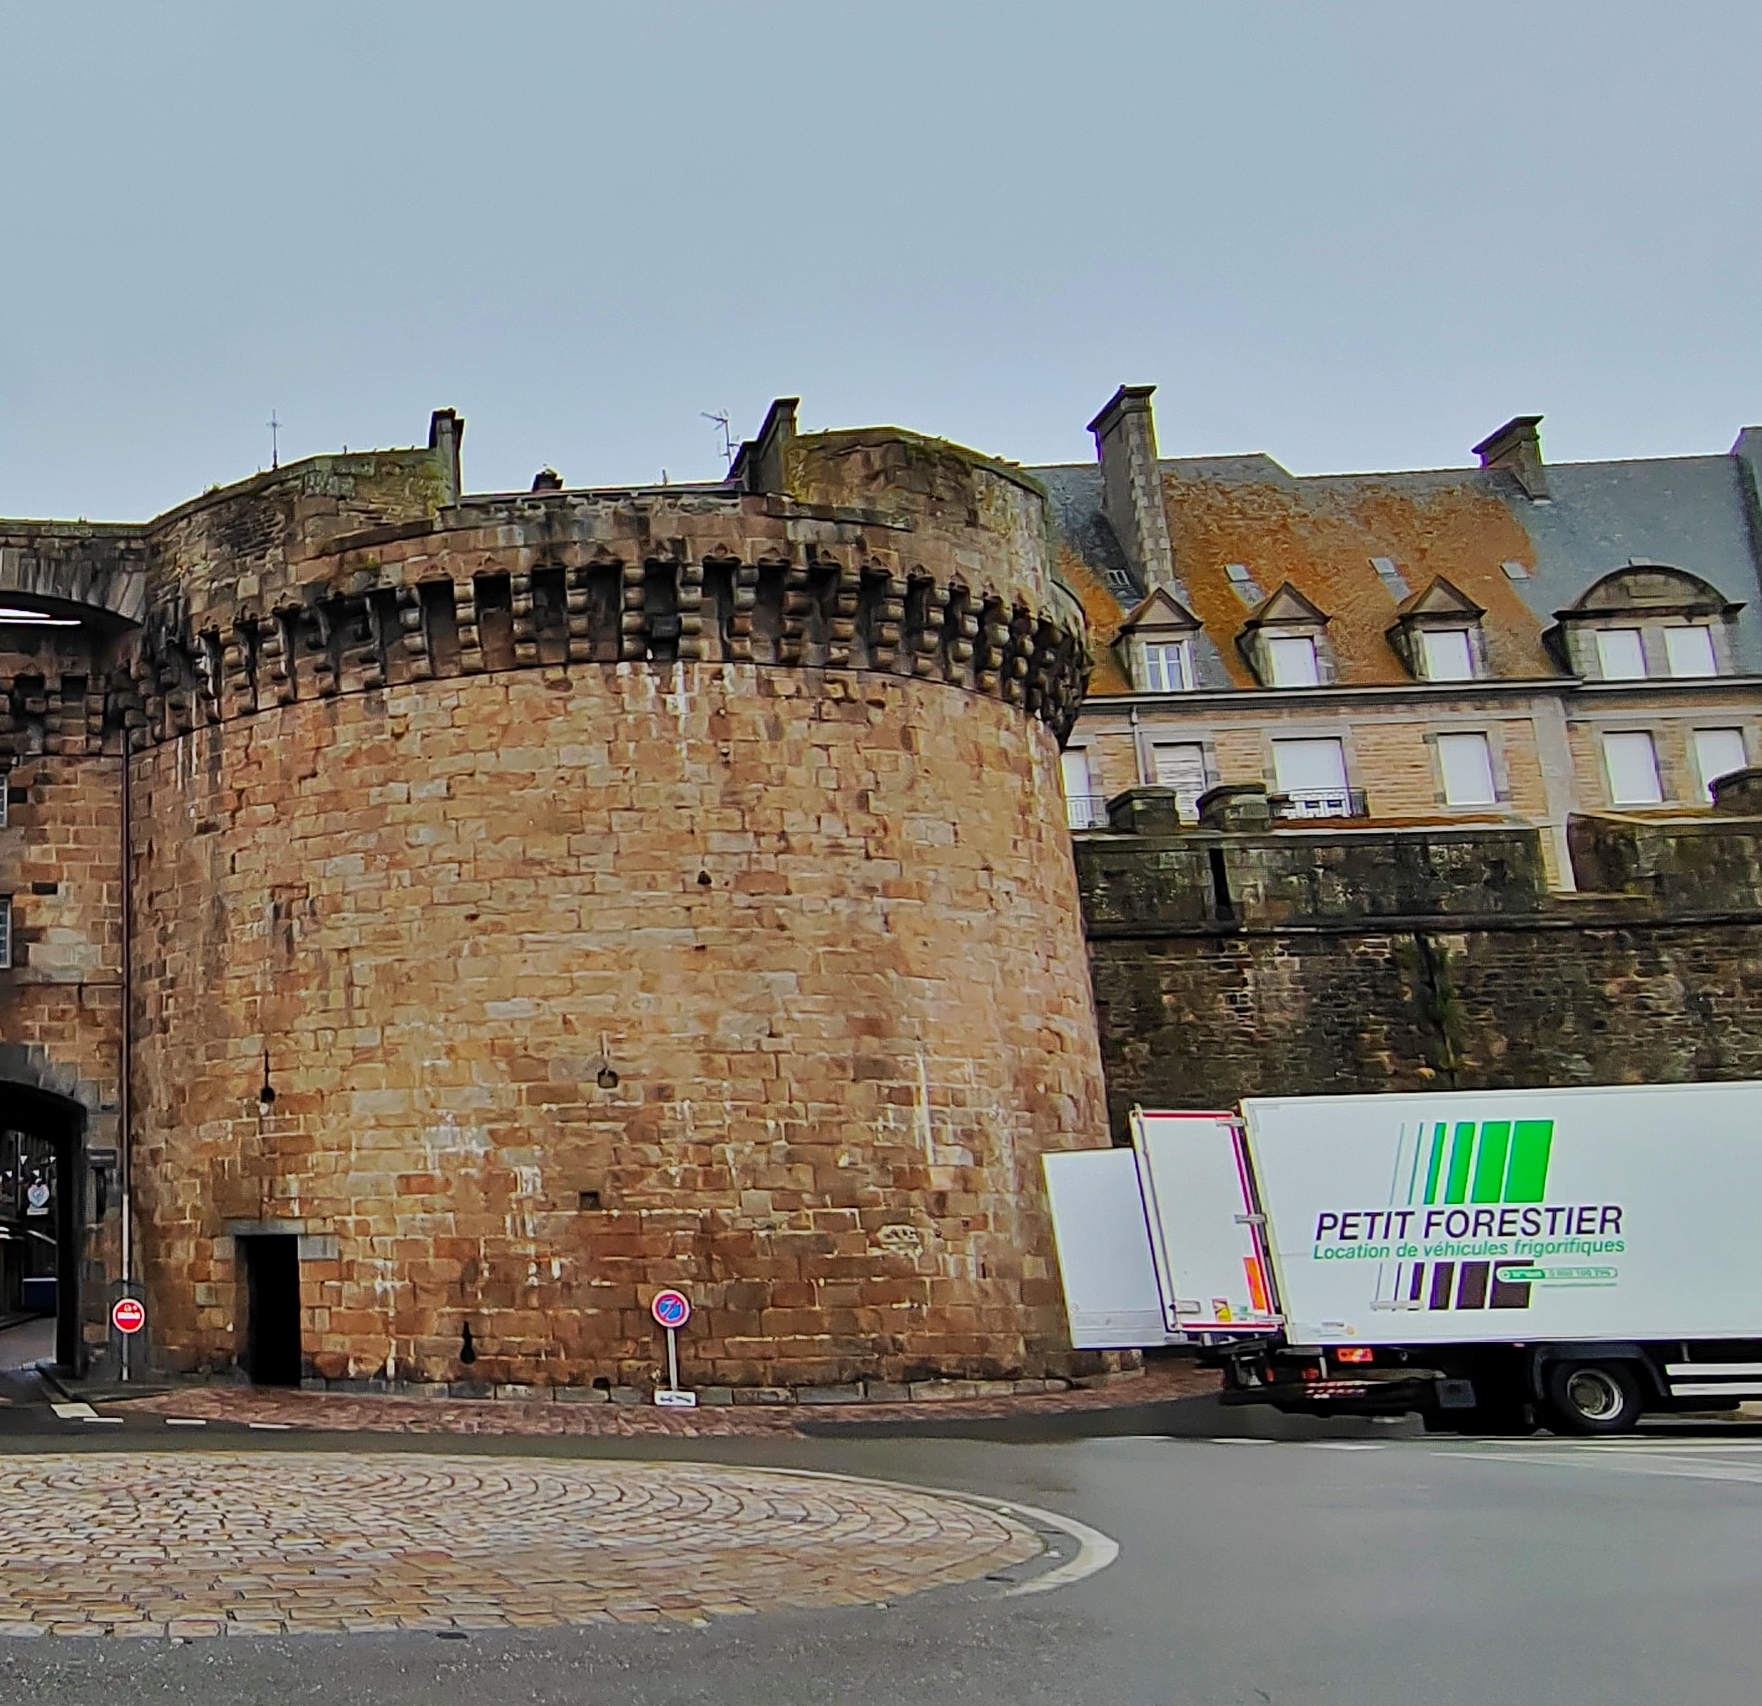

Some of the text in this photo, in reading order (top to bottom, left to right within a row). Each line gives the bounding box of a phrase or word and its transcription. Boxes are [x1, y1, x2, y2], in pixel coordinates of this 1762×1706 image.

[1315, 1206, 1623, 1241] PETIT FORESTIER
[1313, 1237, 1625, 1260] Location de véhicules frigorifiques
